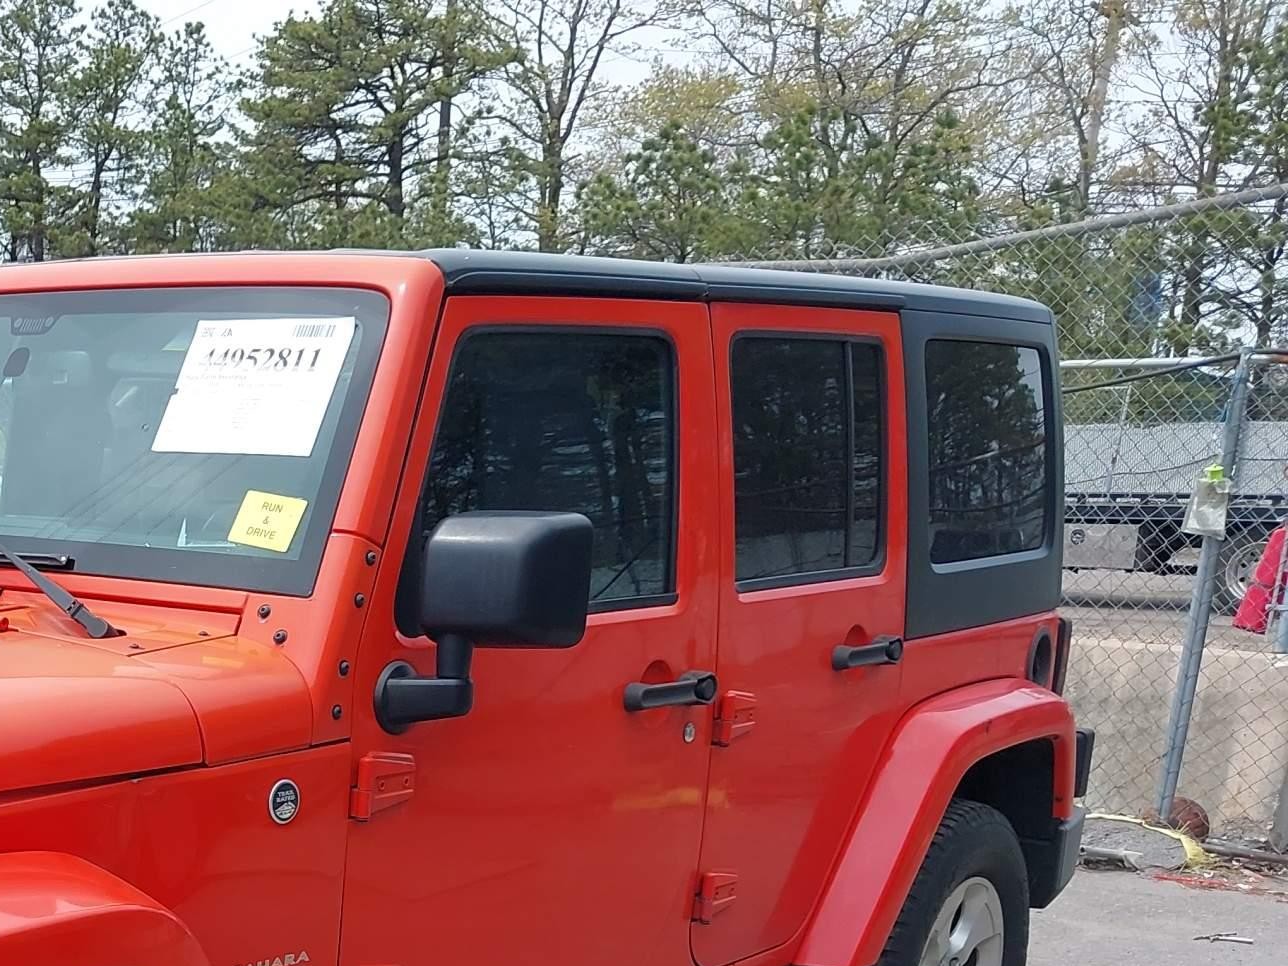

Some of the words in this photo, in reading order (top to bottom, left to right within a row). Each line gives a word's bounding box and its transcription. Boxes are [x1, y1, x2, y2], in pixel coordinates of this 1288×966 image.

[200, 348, 321, 372] 44952811
[261, 501, 283, 513] RUN
[262, 516, 269, 525] &
[245, 526, 277, 540] DRIVE
